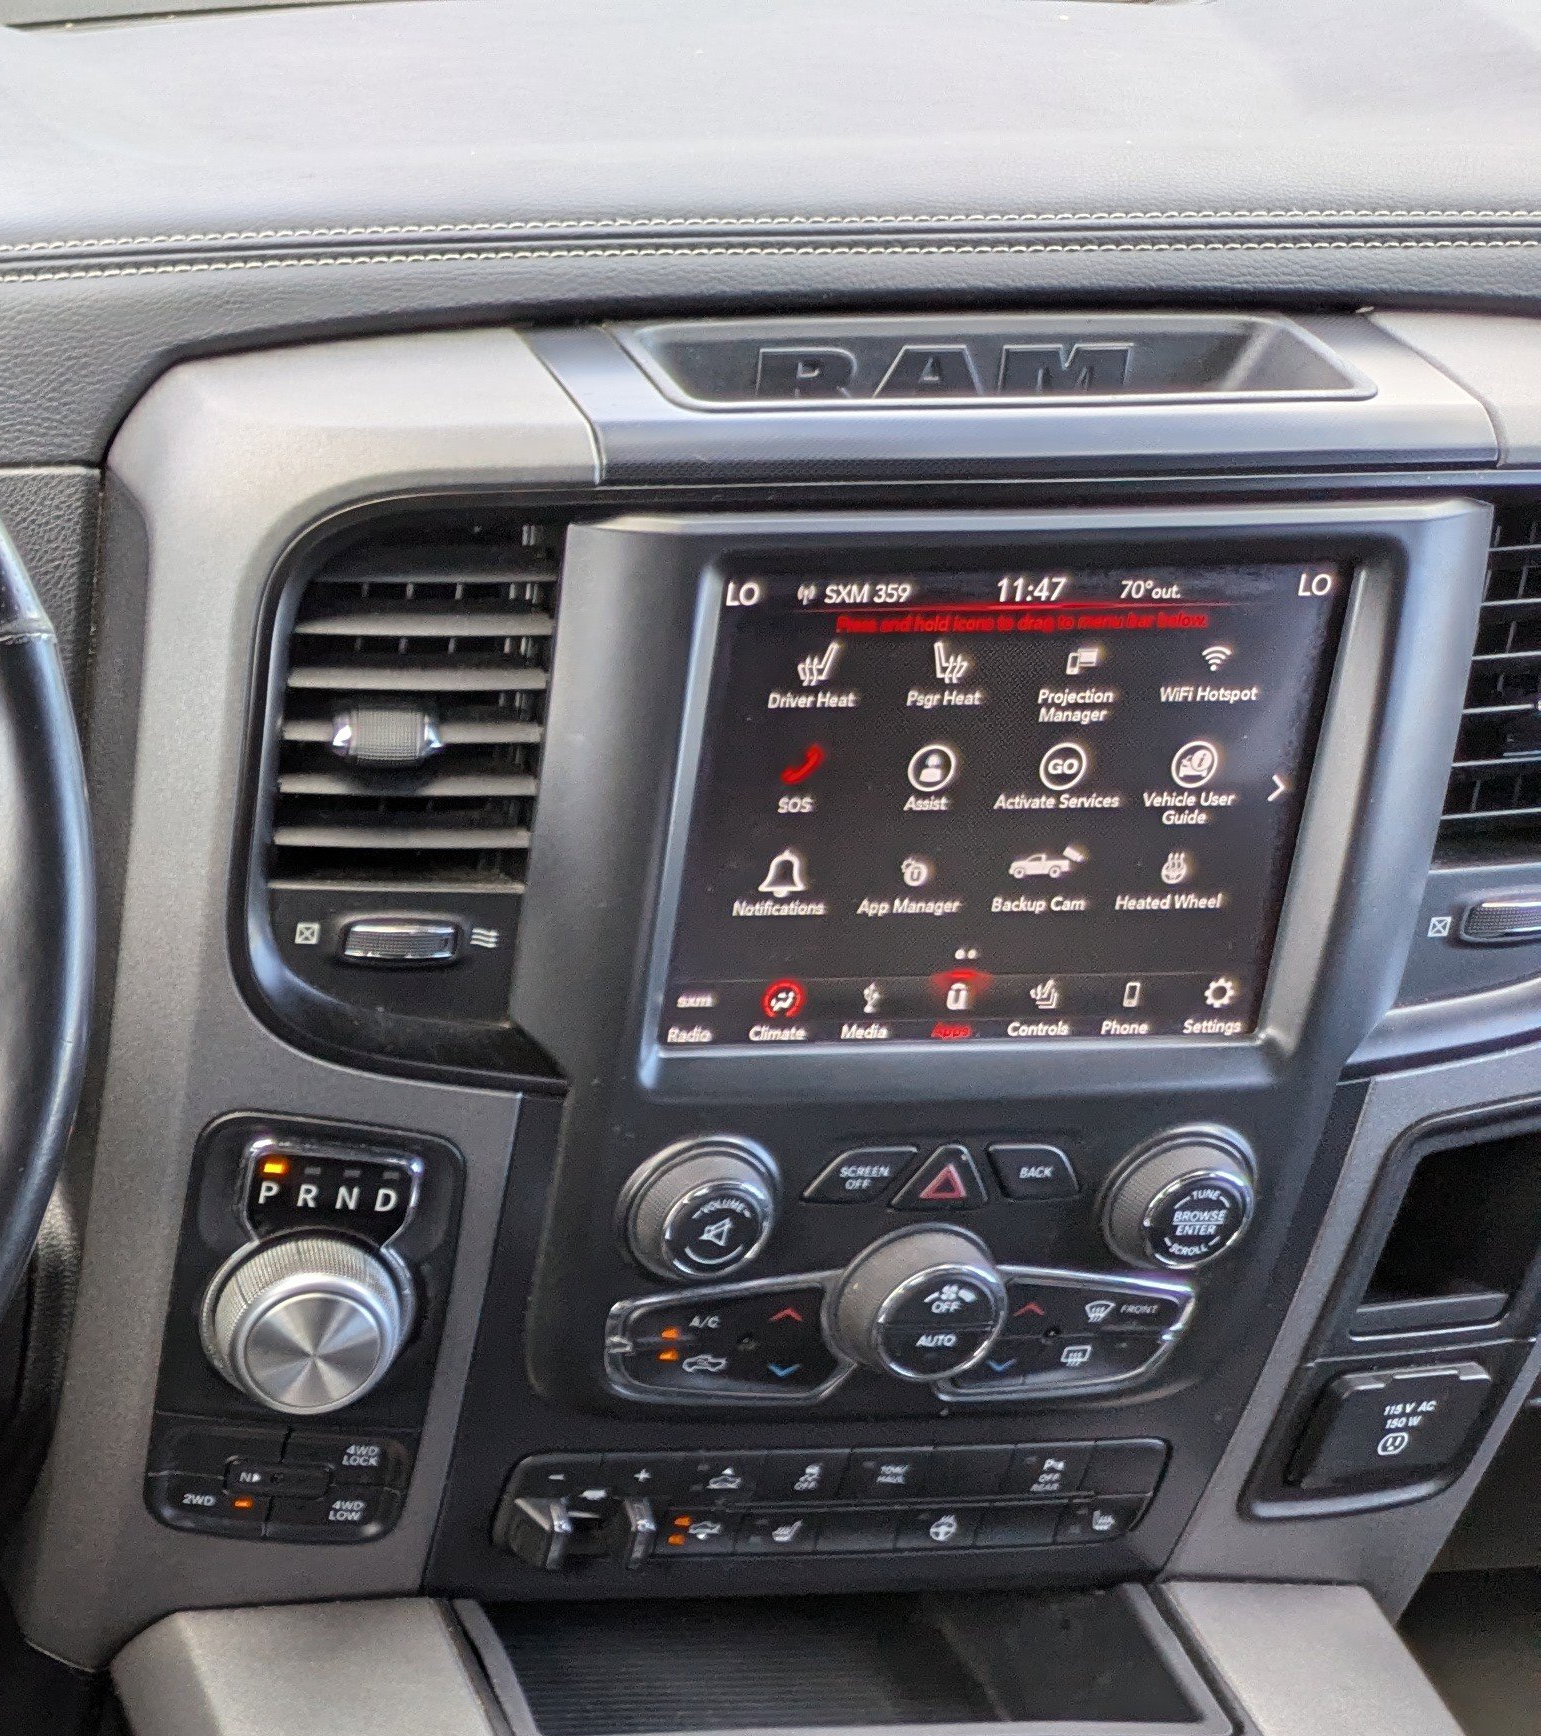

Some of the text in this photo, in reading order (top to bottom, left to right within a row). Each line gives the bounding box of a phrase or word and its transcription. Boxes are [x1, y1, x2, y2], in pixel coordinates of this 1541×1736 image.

[756, 342, 1134, 399] RAM
[824, 583, 912, 603] SXM 359
[997, 577, 1067, 602] 11:47
[1297, 573, 1333, 597] LO
[725, 581, 761, 607] LO
[836, 615, 877, 634] Press
[880, 615, 913, 633] and
[915, 614, 950, 633] hold
[953, 614, 995, 632] icons
[997, 615, 1014, 632] to
[1018, 613, 1055, 633] drag
[1058, 614, 1074, 630] to
[1077, 614, 1123, 629] menu
[1127, 612, 1154, 629] bar
[767, 690, 857, 709] Driver Heat
[905, 689, 982, 707] Psgr Heat
[1037, 687, 1115, 706] Projection
[1160, 685, 1259, 704] WiFi Hotspot
[1038, 706, 1108, 725] Manager
[1047, 758, 1079, 775] GO
[777, 797, 815, 814] SOS
[903, 795, 950, 812] Assist
[993, 793, 1120, 810] Activate Services
[1142, 791, 1235, 807] Vehicle User
[1161, 809, 1208, 826] Guide
[732, 899, 827, 917] Notifications
[856, 898, 963, 917] App Manager
[991, 896, 1086, 914] Backup Cam
[1114, 893, 1223, 911] Heated Wheel
[667, 1025, 713, 1043] Radio
[749, 1024, 807, 1041] Climate
[840, 1023, 889, 1040] Media
[1007, 1021, 1069, 1037] Controls
[1100, 1020, 1149, 1036] Phone
[1182, 1018, 1242, 1036] Settings
[839, 1165, 891, 1178] SCREEN
[1019, 1166, 1054, 1179] BACK
[845, 1178, 873, 1190] OFF
[258, 1184, 399, 1213] P R N D
[1192, 1188, 1222, 1201] TUNE
[701, 1198, 746, 1214] VOLUME
[1172, 1209, 1228, 1222] BROWSE
[1175, 1224, 1217, 1236] ENTER
[1168, 1242, 1210, 1257] SCROLL
[931, 1300, 963, 1314] OFF
[1120, 1304, 1159, 1315] FRONT
[688, 1315, 721, 1329] A/C
[915, 1333, 957, 1348] AUTO
[1383, 1400, 1438, 1416] 115 V AC
[1385, 1415, 1423, 1429] 150 W
[345, 1444, 382, 1456] 4WD
[341, 1455, 380, 1467] LOCK
[181, 1493, 217, 1507] 2WD
[331, 1499, 366, 1511] 4WD
[328, 1510, 362, 1522] LOW
